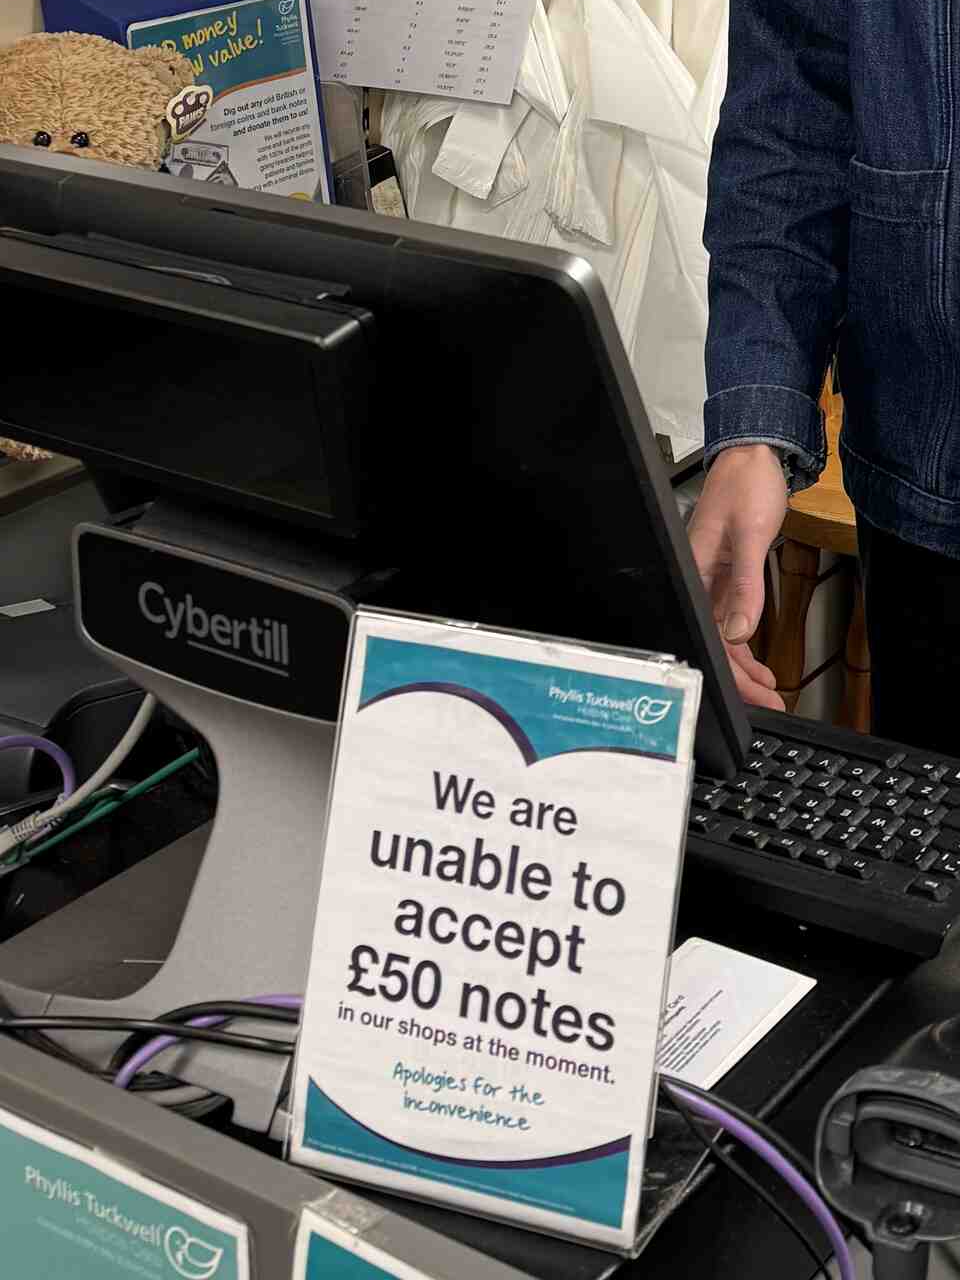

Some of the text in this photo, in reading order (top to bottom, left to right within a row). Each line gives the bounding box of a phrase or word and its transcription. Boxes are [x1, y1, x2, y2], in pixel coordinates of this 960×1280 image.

[182, 11, 239, 51] money
[209, 16, 264, 67] value!
[138, 581, 289, 666] Cybertill
[549, 686, 636, 712] Phyllis Tuckwell
[433, 771, 578, 836] We are
[370, 830, 626, 916] unable to
[394, 898, 586, 975] accept
[346, 944, 442, 1010] £50
[459, 980, 616, 1051] notes
[337, 1001, 616, 1085] in our shops at the moment.
[392, 1061, 545, 1107] Apologies for the
[403, 1093, 533, 1132] inconvenience
[24, 1165, 162, 1247] Phyllis Tuckwell
